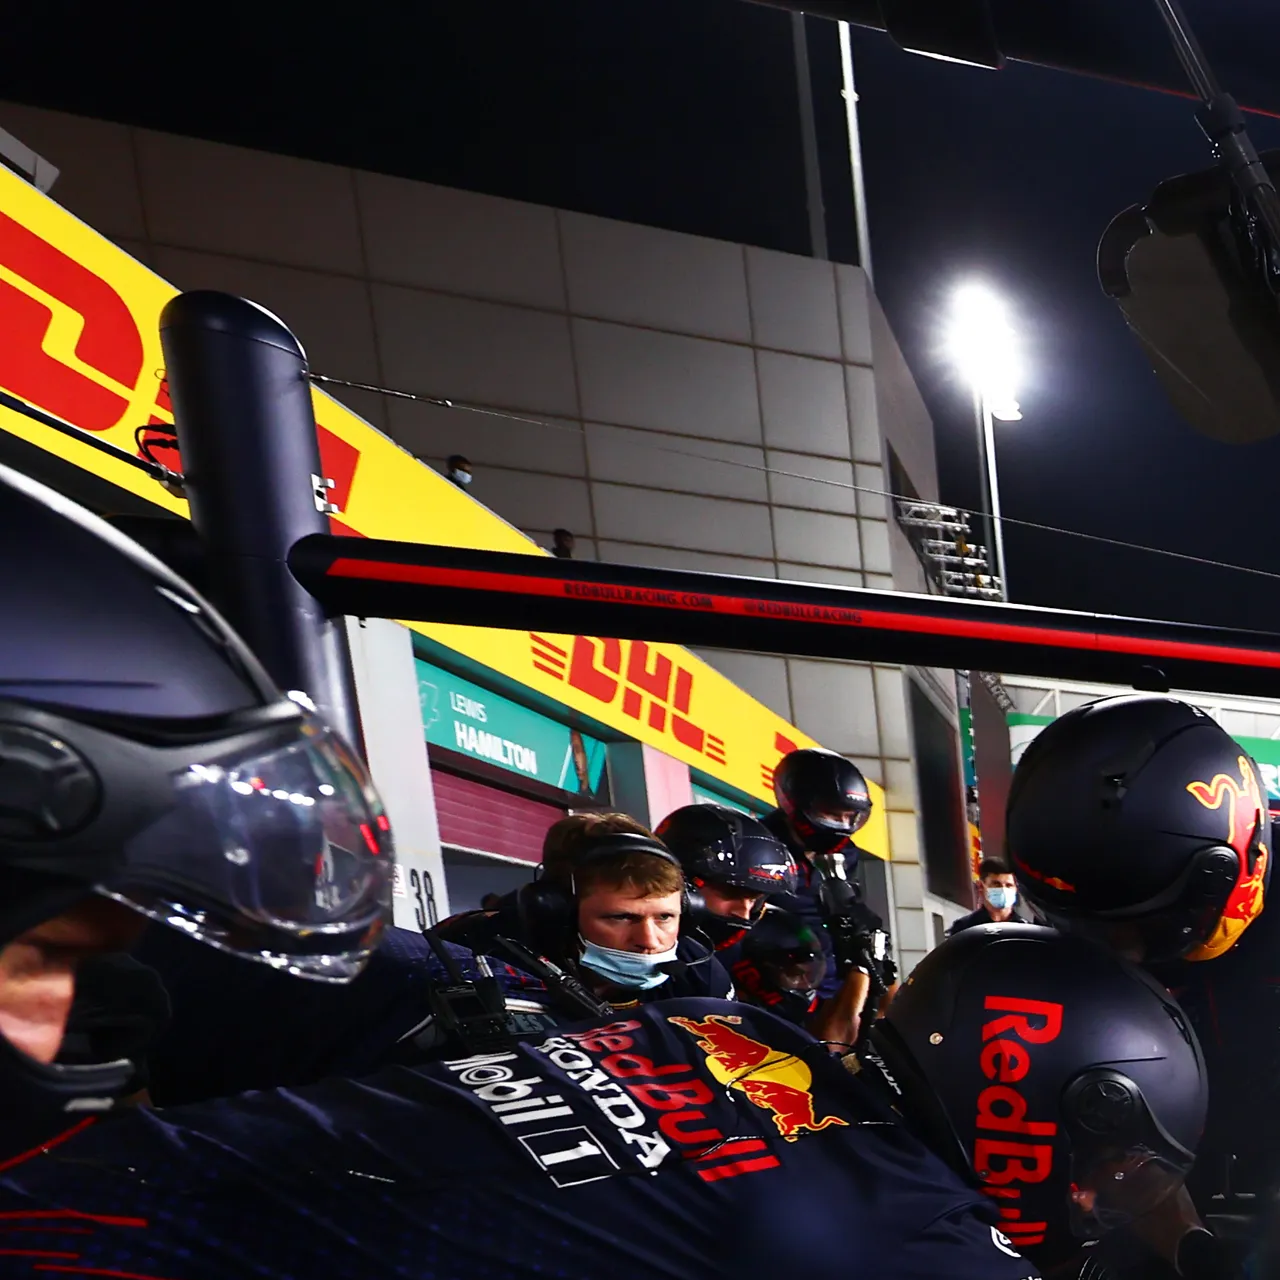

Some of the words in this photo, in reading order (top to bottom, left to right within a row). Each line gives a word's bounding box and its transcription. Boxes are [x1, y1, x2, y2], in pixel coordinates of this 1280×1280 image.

[449, 691, 488, 723] LEWIS
[568, 635, 705, 753] DHL
[453, 720, 538, 775] HAMILTON
[410, 868, 439, 931] 38
[440, 1050, 575, 1126] Mobil
[562, 1019, 695, 1078] Red
[976, 995, 1064, 1136] Red
[534, 1037, 672, 1169] HONDA
[626, 1077, 782, 1183] Bull
[973, 1137, 1054, 1247] Bull
